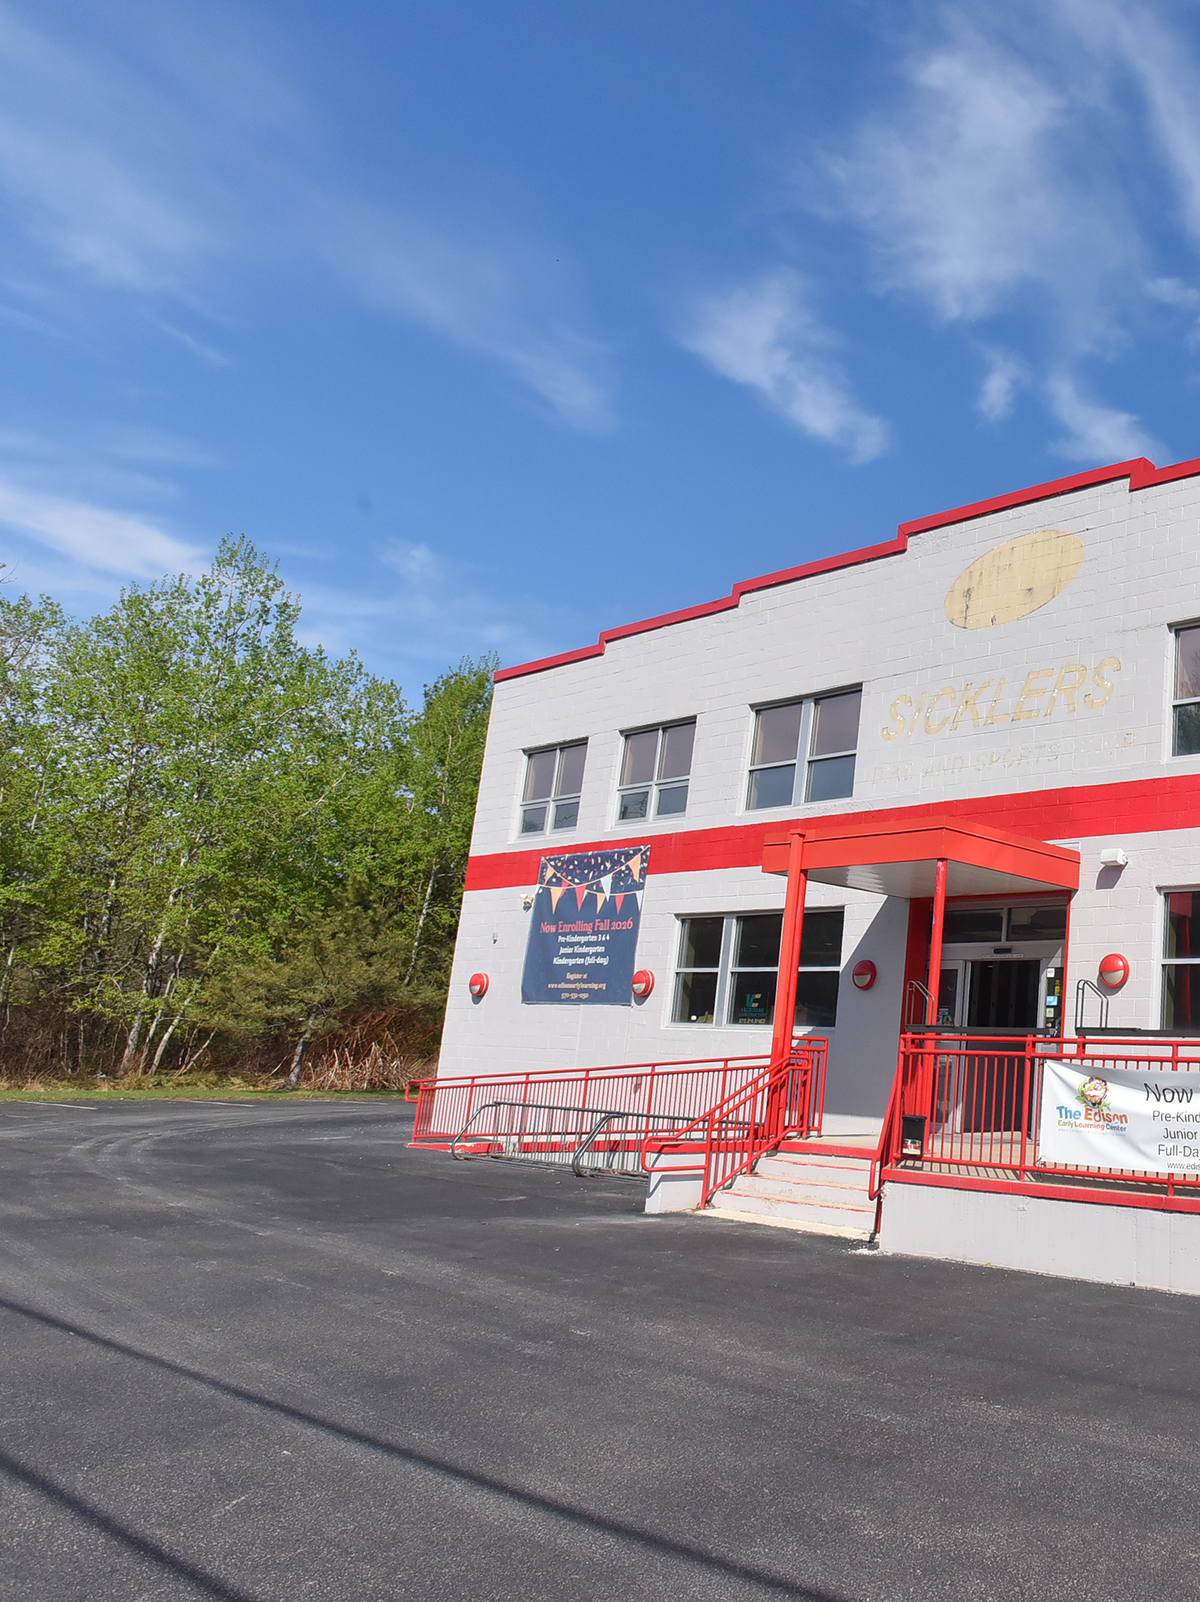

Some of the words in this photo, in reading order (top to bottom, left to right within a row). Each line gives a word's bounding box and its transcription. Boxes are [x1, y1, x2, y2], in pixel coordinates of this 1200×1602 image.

[881, 657, 1121, 741] SICKLERS
[540, 921, 556, 934] Now
[558, 920, 593, 934] Enrolling
[594, 918, 610, 931] Fall
[611, 917, 633, 930] 2026
[573, 945, 605, 954] Kindergarten
[553, 956, 584, 966] Kindergarten
[1144, 1082, 1193, 1104] Now
[1056, 1105, 1082, 1120] The
[1084, 1107, 1129, 1124] Edison
[1057, 1120, 1074, 1128] Early
[1074, 1121, 1105, 1131] Learning
[1105, 1123, 1127, 1132] Center
[1162, 1127, 1198, 1141] Junior
